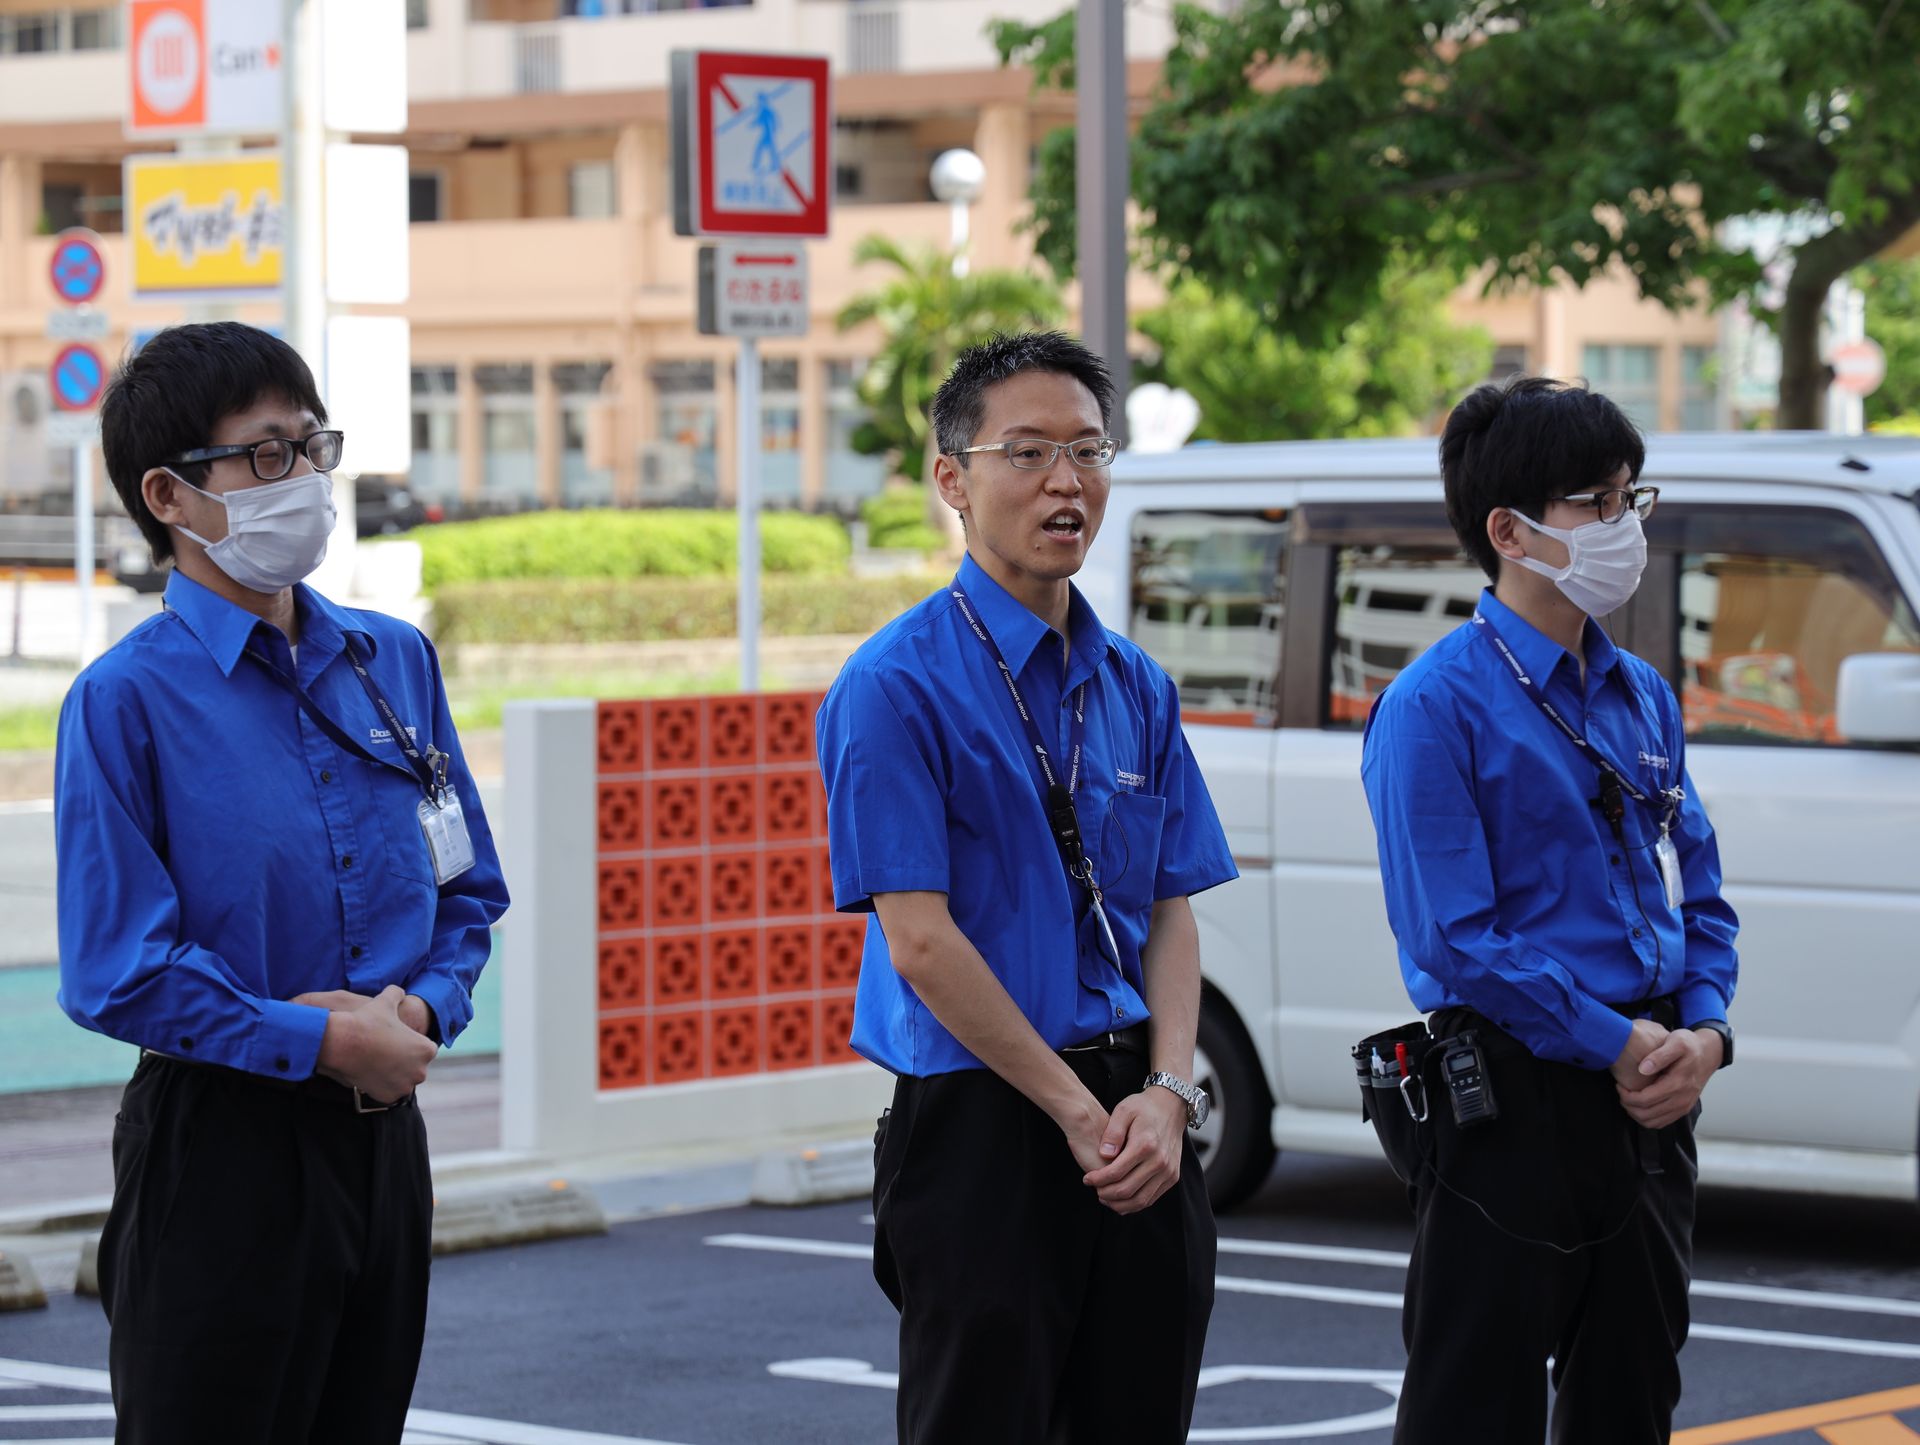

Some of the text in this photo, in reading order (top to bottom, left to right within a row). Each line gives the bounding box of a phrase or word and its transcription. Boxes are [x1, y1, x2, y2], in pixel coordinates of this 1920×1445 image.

[957, 597, 987, 641] THIRDWAVE GROUP
[1003, 670, 1029, 721] THIRDWAVE GROUP
[377, 698, 411, 748] THIRDWAVE GROUP
[1041, 755, 1056, 787] THIRDWAVE
[1068, 764, 1079, 794] THIRDWAVE
